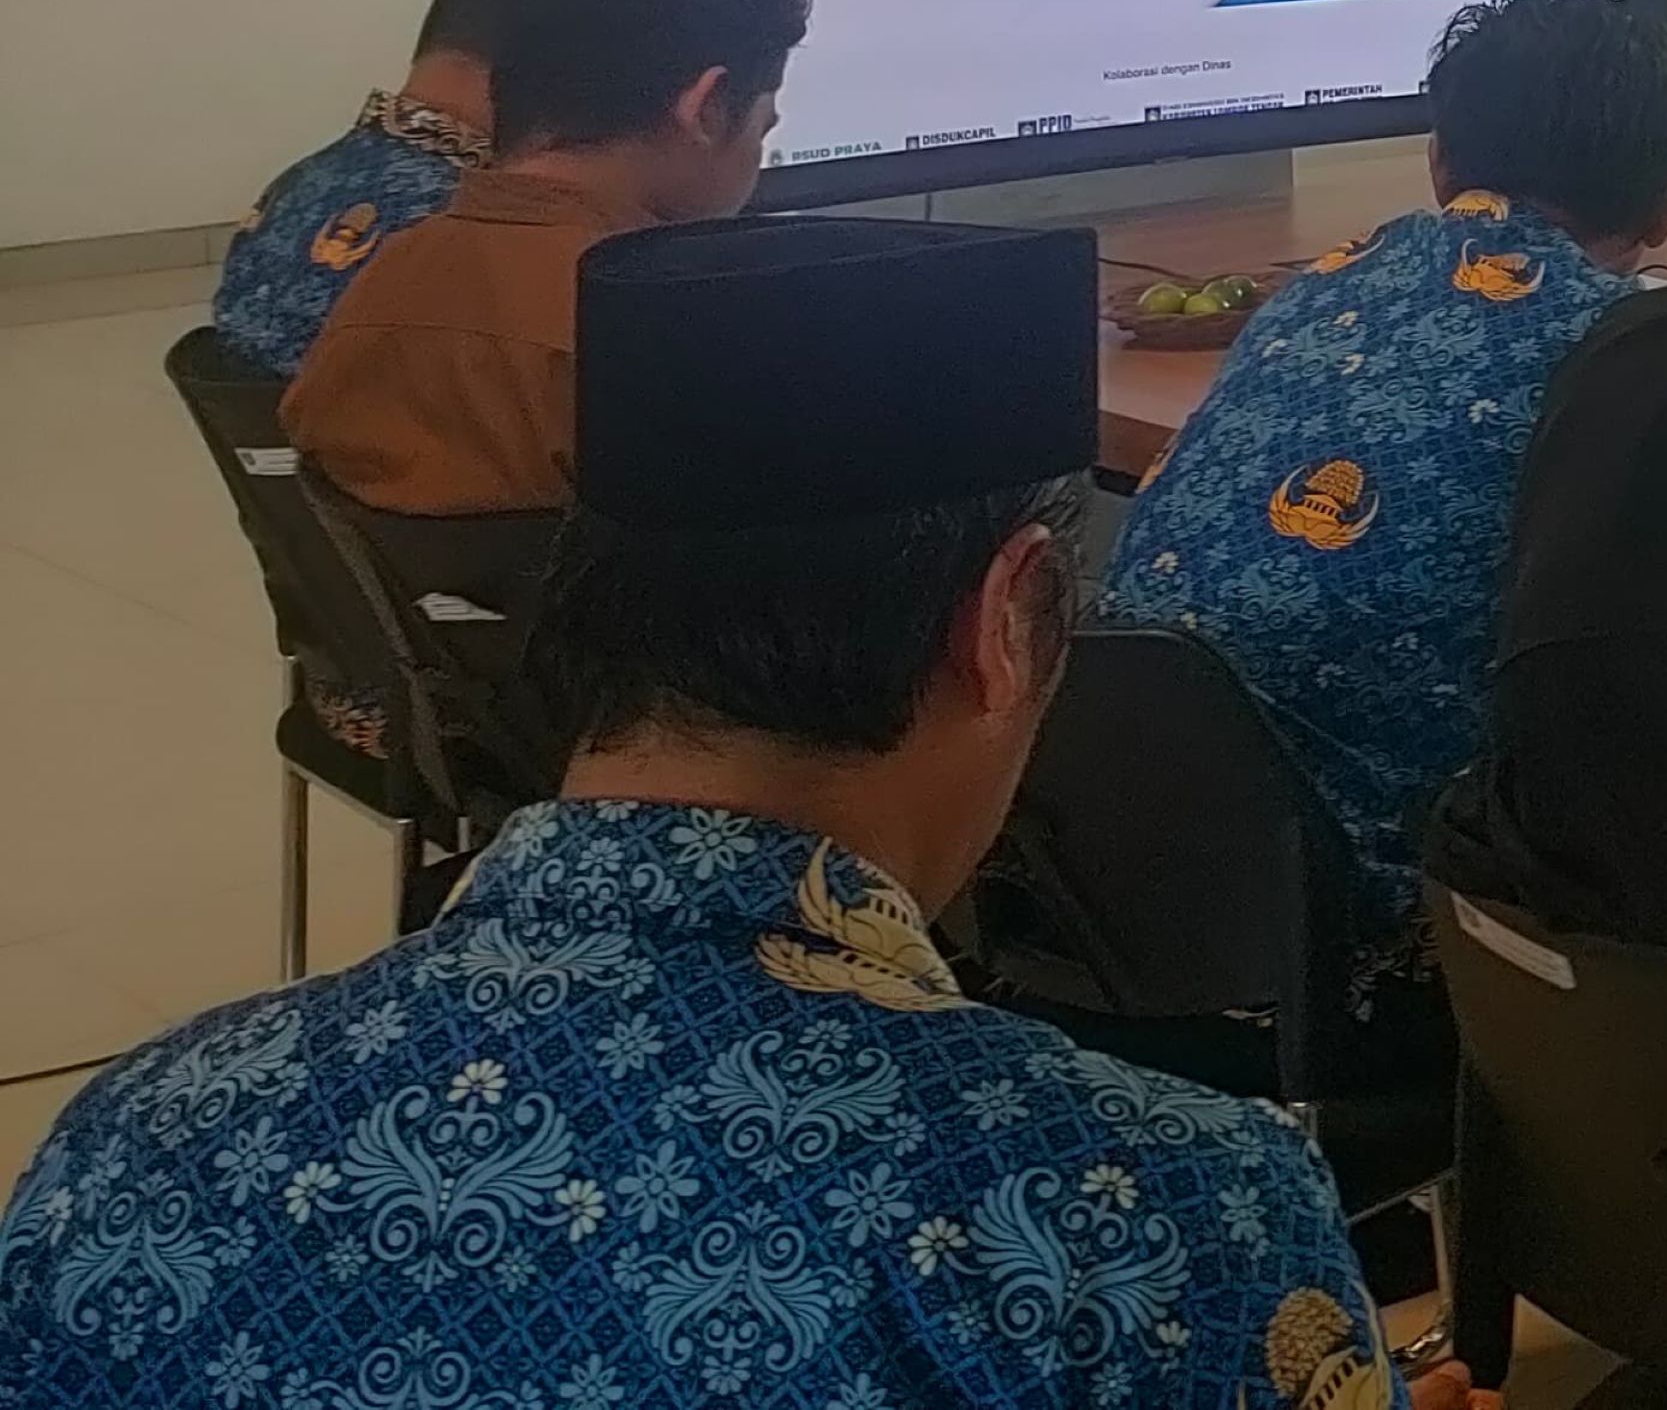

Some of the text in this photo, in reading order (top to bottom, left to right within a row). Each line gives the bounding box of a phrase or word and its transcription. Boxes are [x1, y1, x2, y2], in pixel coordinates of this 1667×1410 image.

[1103, 59, 1232, 81] Kolaborasi dengan Dinas
[922, 126, 996, 146] DISDUKCAPIL
[792, 140, 883, 162] RSUD PRAYA
